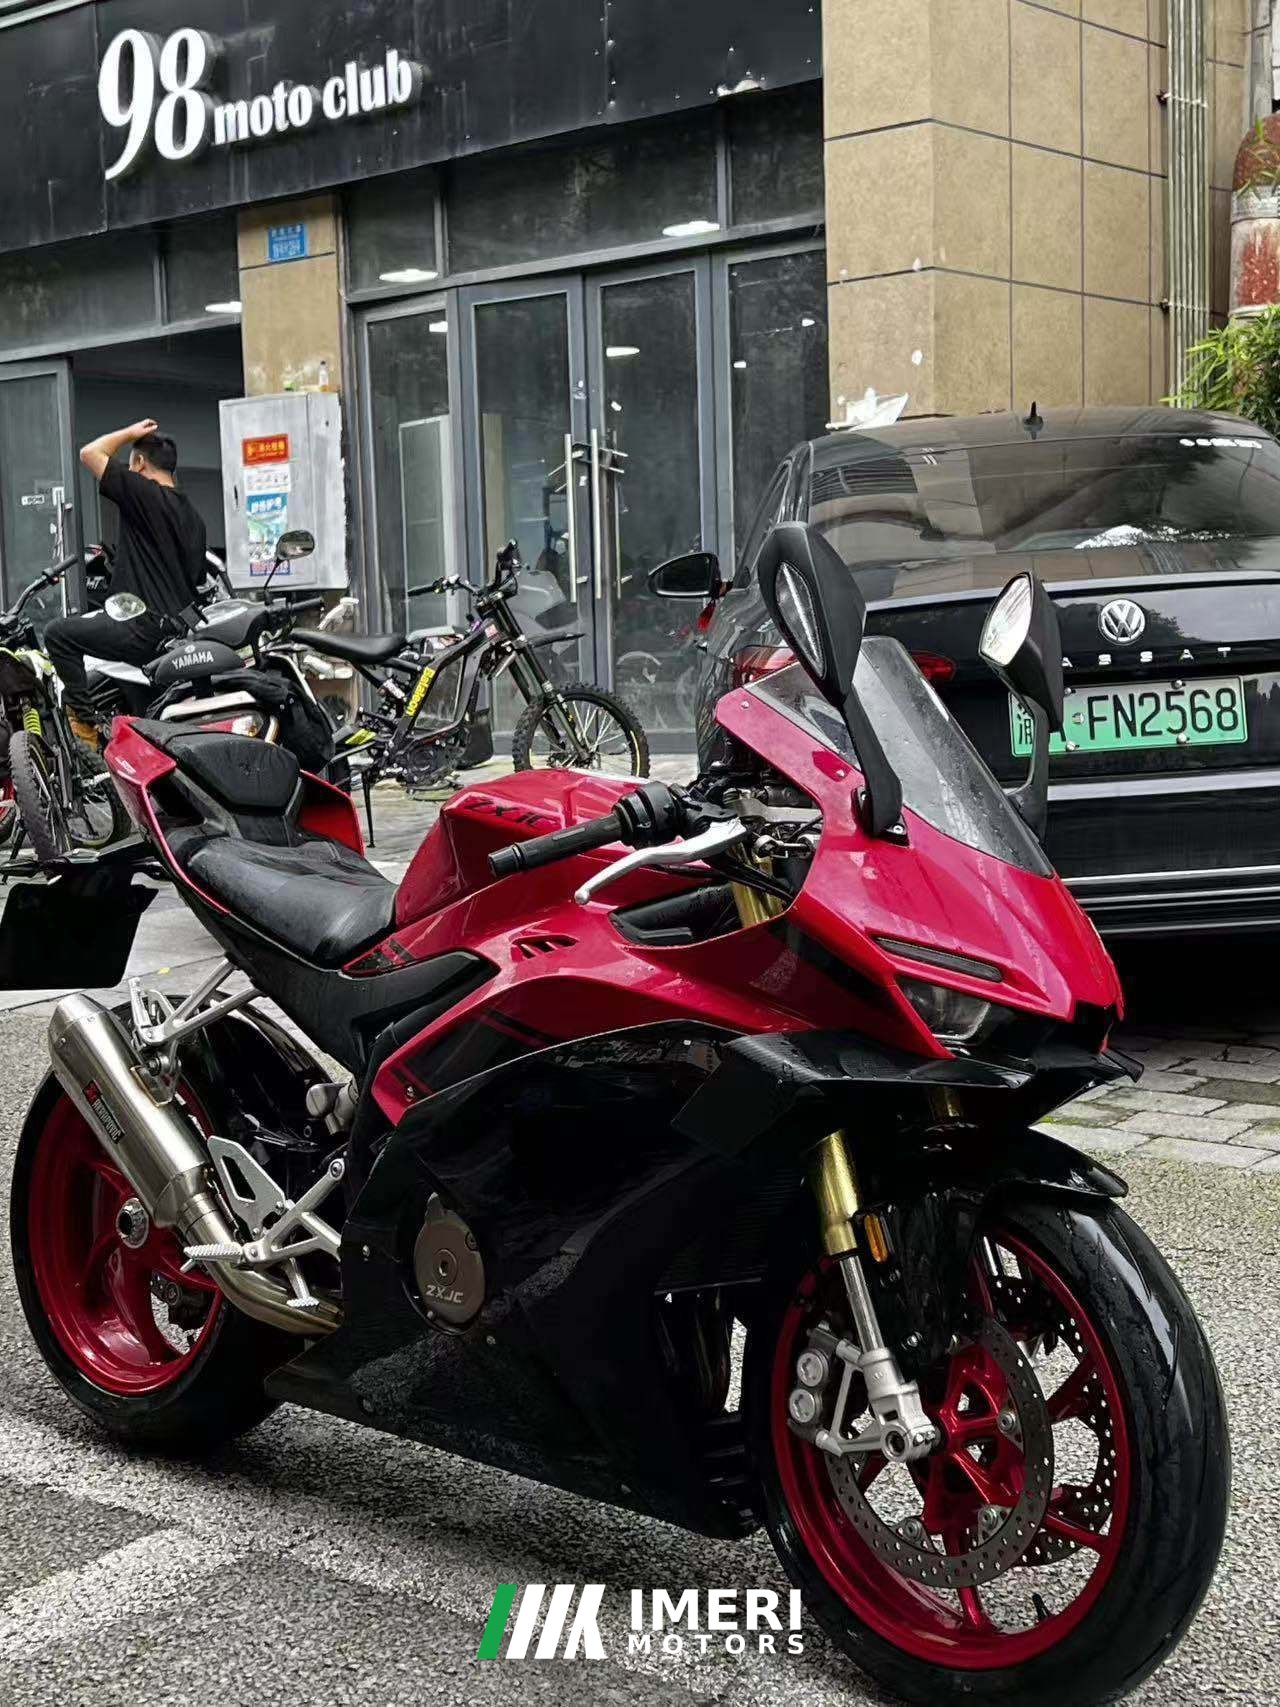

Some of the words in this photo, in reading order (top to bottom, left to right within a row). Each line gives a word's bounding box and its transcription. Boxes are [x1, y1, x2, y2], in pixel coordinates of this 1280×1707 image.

[97, 28, 207, 181] 98
[213, 79, 313, 145] moto
[322, 49, 414, 120] club
[171, 651, 215, 670] YAMAHA
[1061, 646, 1232, 668] ASSAT
[1087, 687, 1239, 741] FN2568
